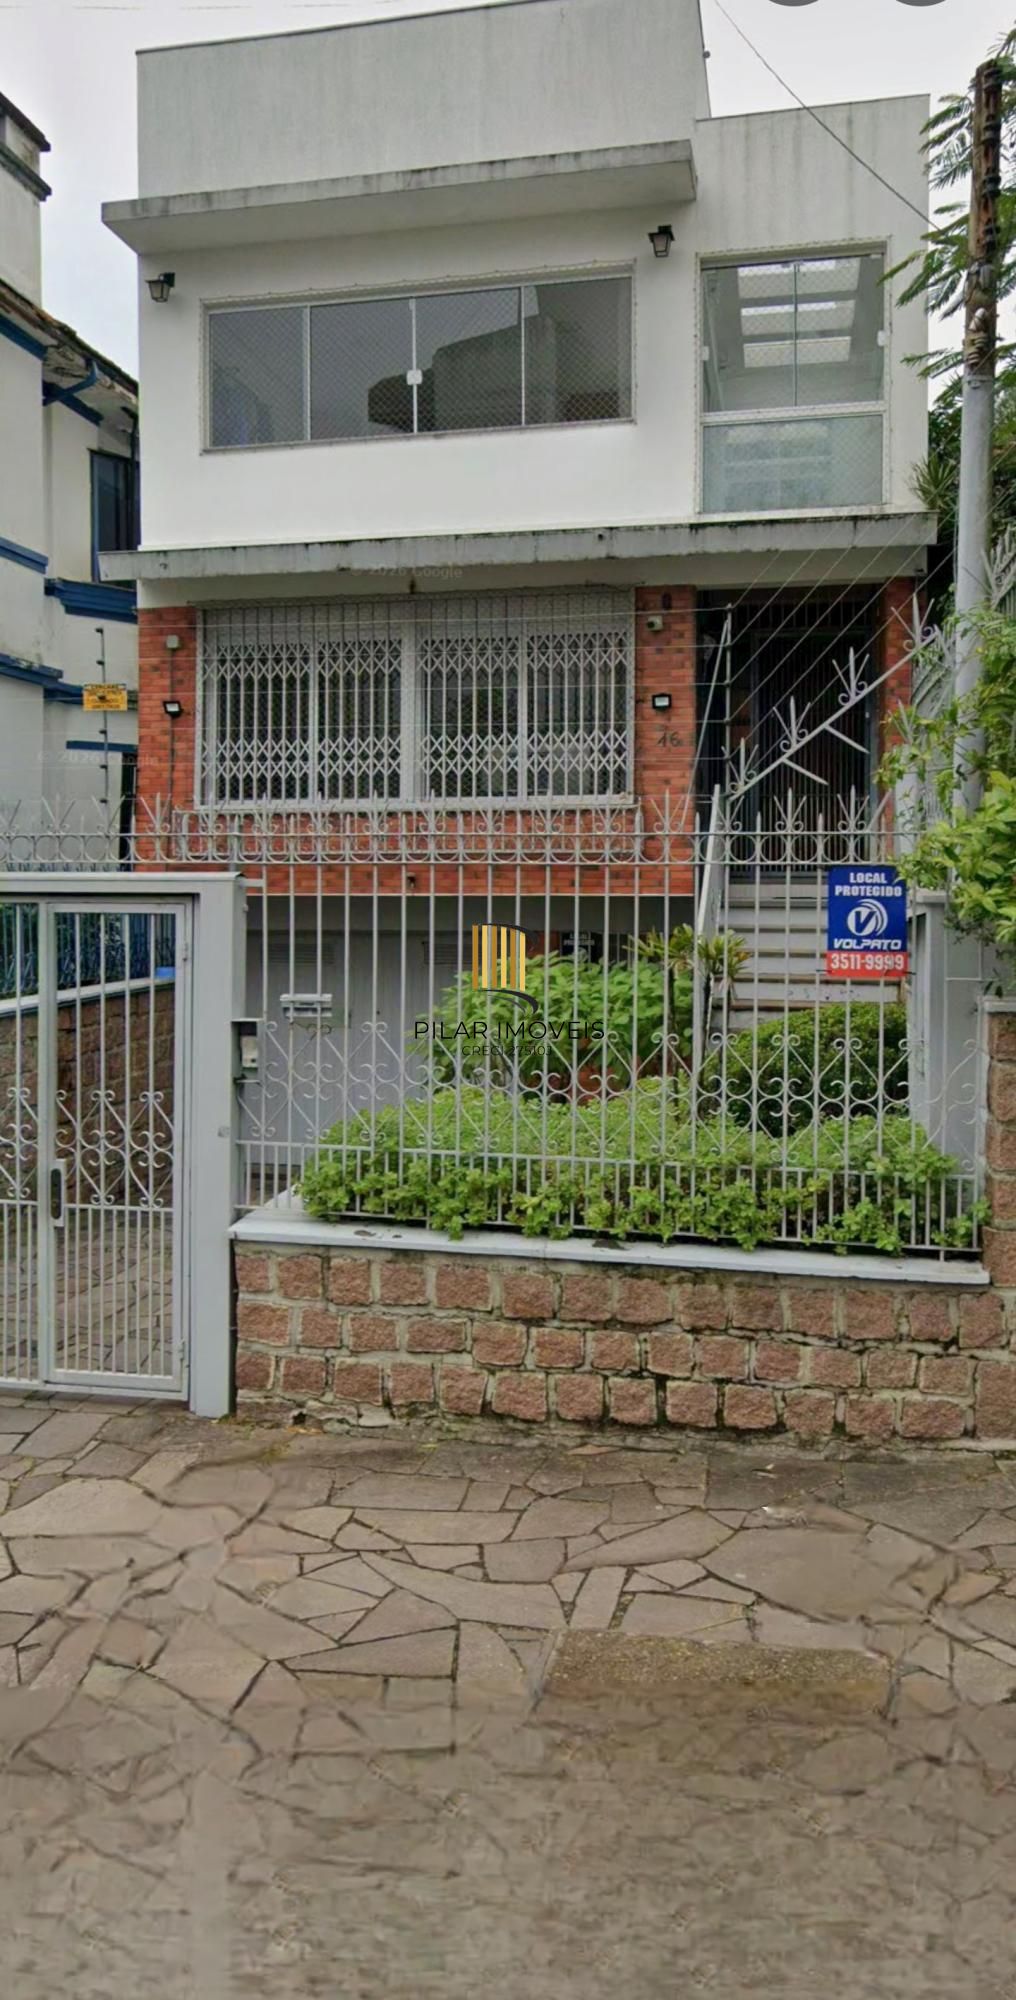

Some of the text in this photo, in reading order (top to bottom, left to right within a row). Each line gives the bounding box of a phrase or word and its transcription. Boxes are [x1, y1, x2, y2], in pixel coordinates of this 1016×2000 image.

[849, 872, 888, 884] LOCAL
[834, 885, 903, 897] PROTEGIDO
[833, 938, 903, 950] VOLPATO
[830, 953, 905, 971] 3511-9999
